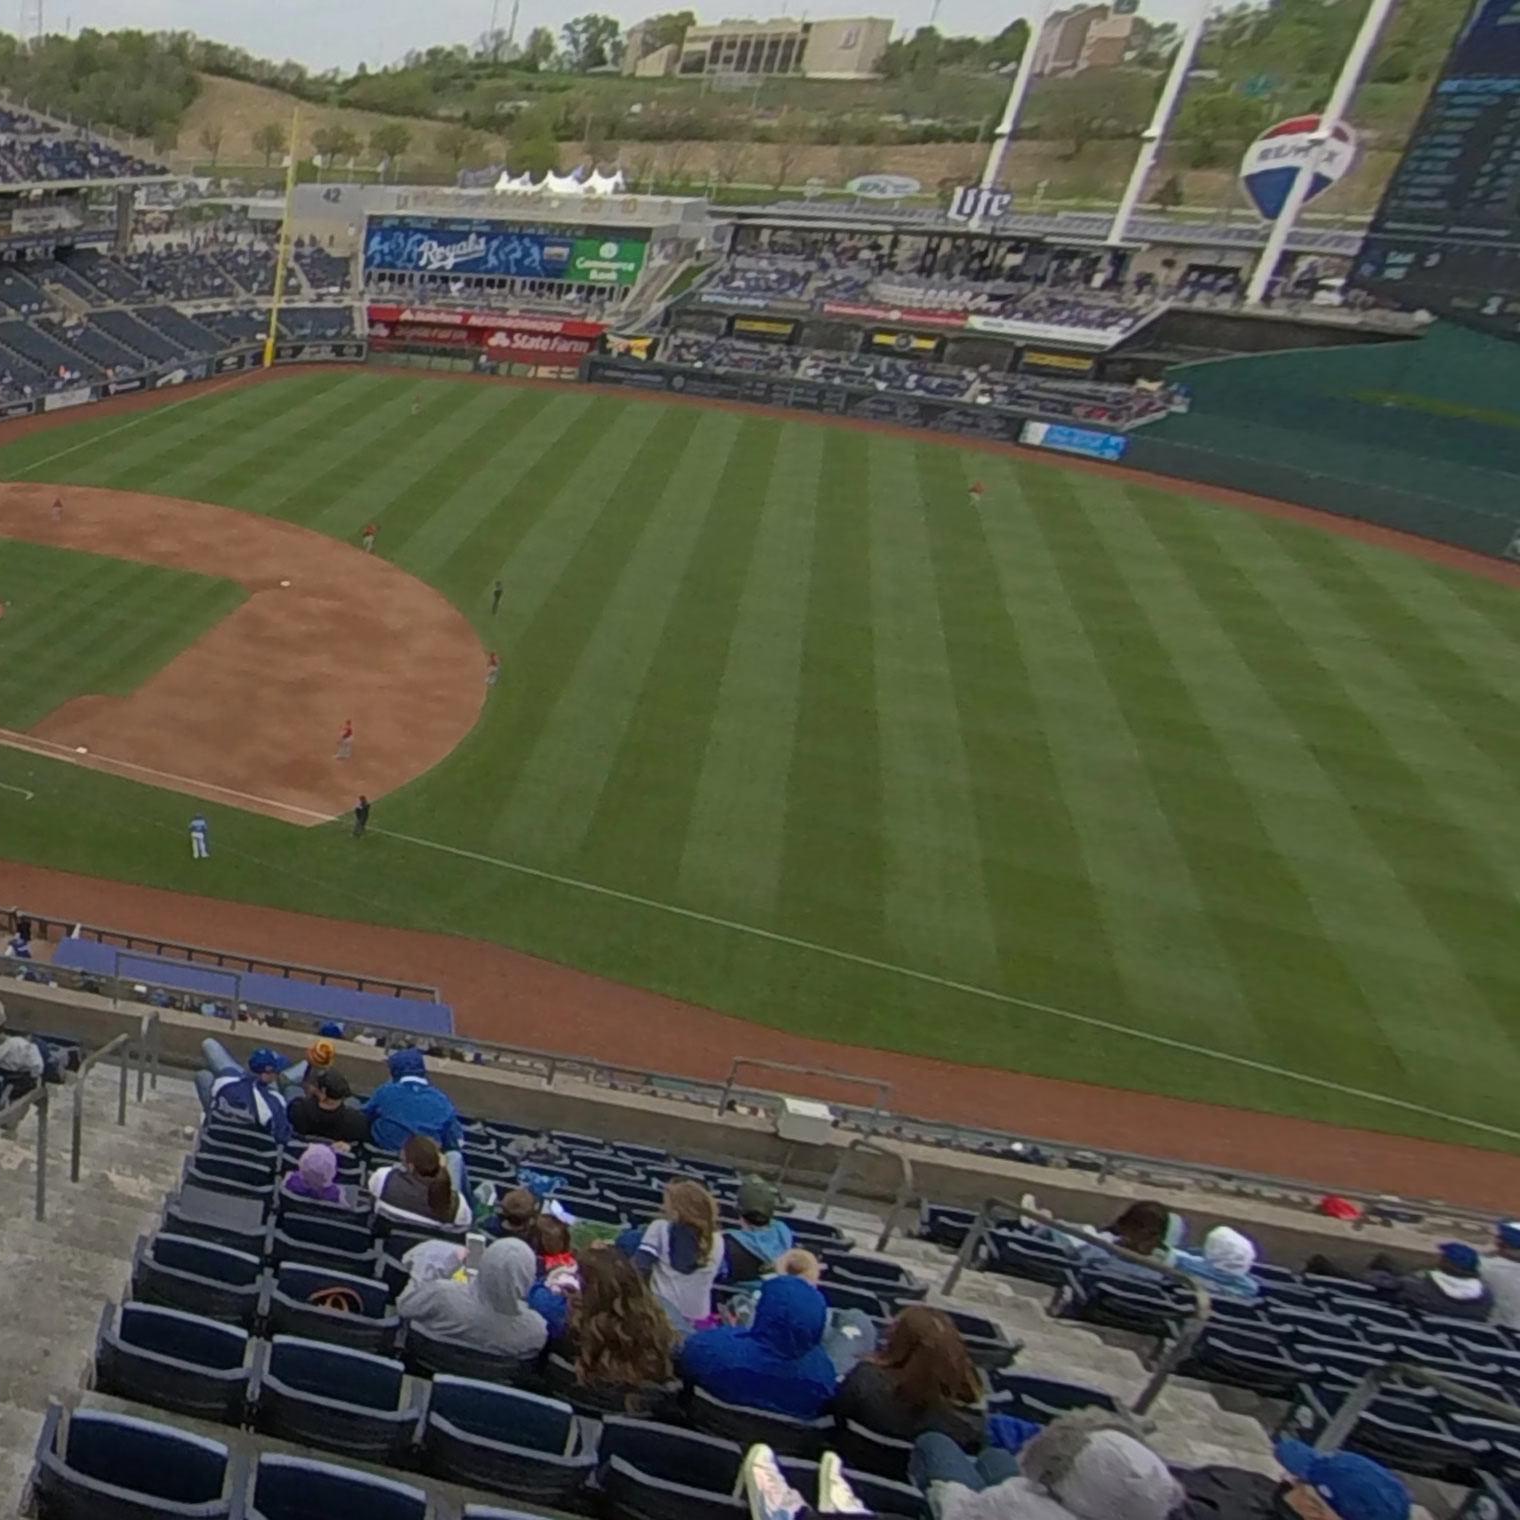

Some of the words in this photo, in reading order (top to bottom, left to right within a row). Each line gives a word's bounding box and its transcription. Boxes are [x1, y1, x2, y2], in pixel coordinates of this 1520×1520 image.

[322, 187, 342, 204] 42
[416, 232, 487, 271] Royals
[574, 256, 636, 272] Commerce
